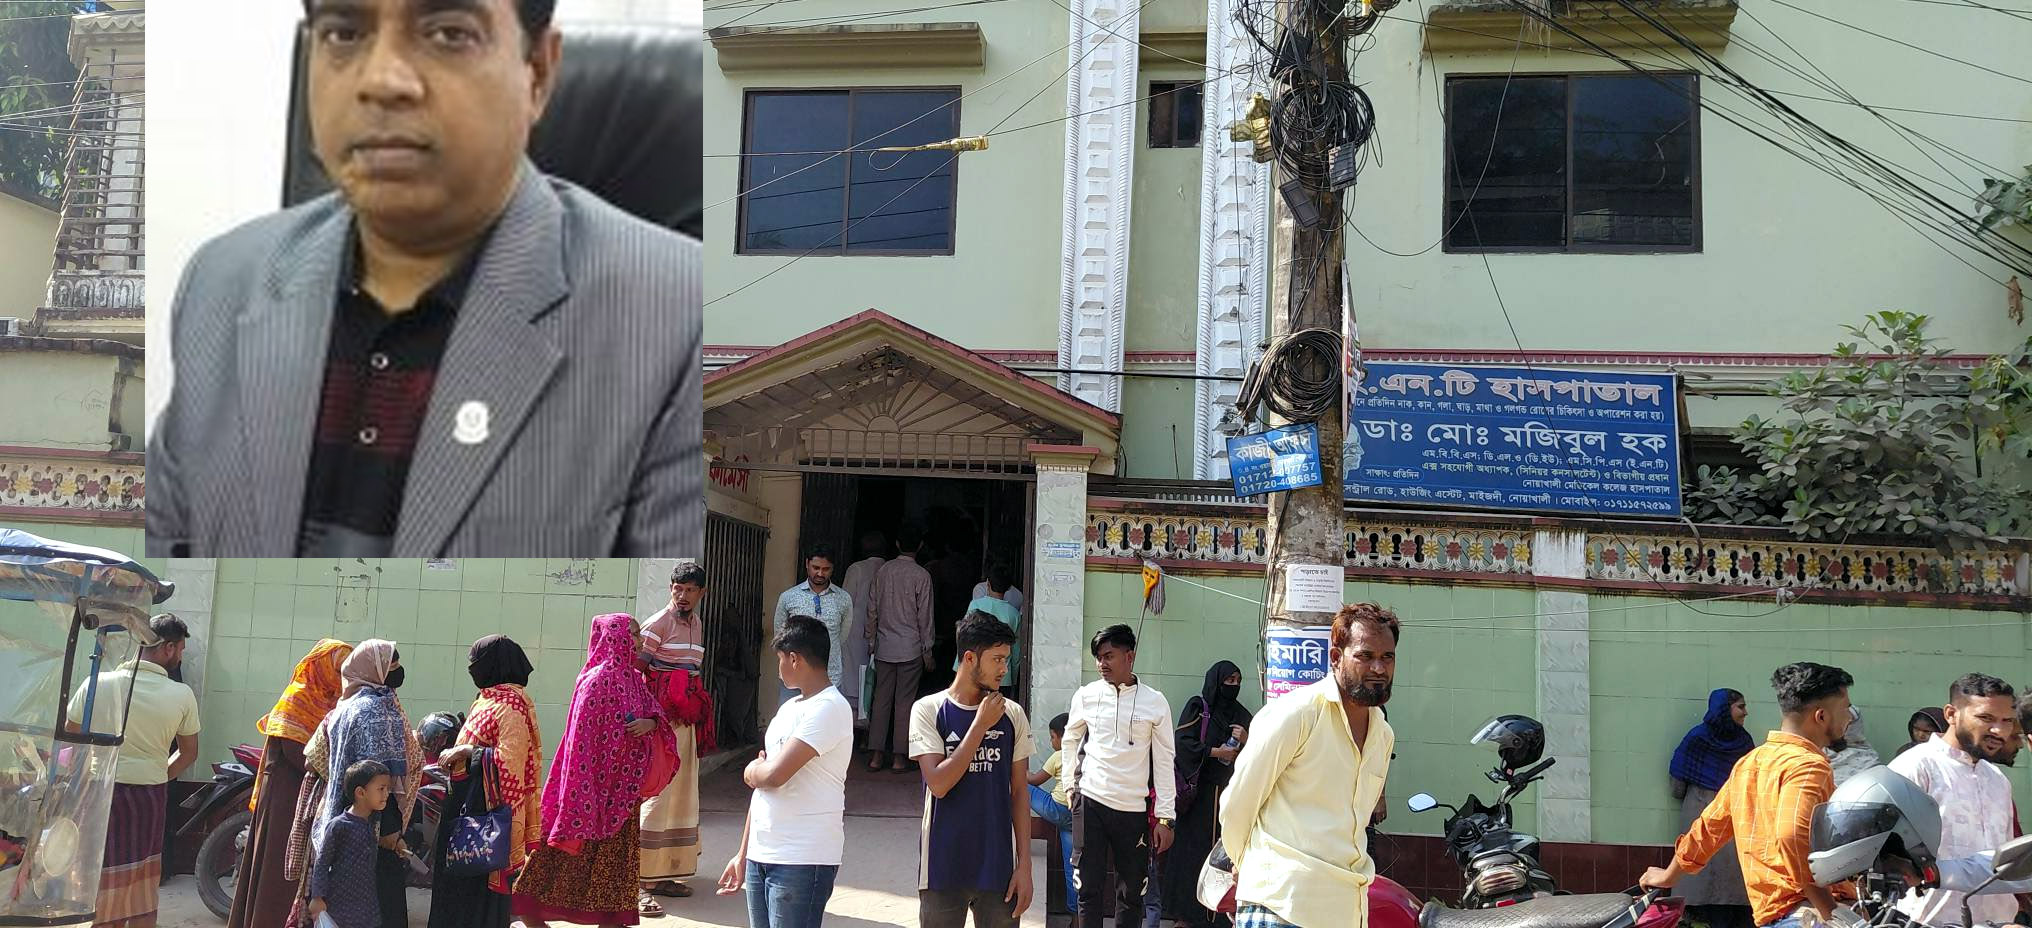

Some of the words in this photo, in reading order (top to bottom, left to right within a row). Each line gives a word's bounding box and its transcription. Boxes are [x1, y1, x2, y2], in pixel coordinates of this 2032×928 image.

[1486, 376, 1664, 407] হাসপাতাল
[1368, 396, 1396, 408] প্রতিদিন
[1475, 403, 1493, 413] মাথা
[1495, 405, 1502, 413] ও
[1530, 405, 1555, 415] রোগের
[1556, 404, 1586, 417] চিকিৎসা
[1588, 408, 1595, 417] ও
[1596, 409, 1631, 419] অপারেশন
[1633, 410, 1649, 420] করা
[1233, 437, 1271, 462] কাজী
[1359, 419, 1413, 442] ডাঃ
[1427, 423, 1489, 446] মোঃ
[1498, 421, 1609, 457] মজিবুল
[1616, 432, 1668, 457] হক
[1604, 471, 1611, 480] ও
[1603, 483, 1628, 493] কলেজ
[1630, 484, 1671, 496] হাসপাতাল
